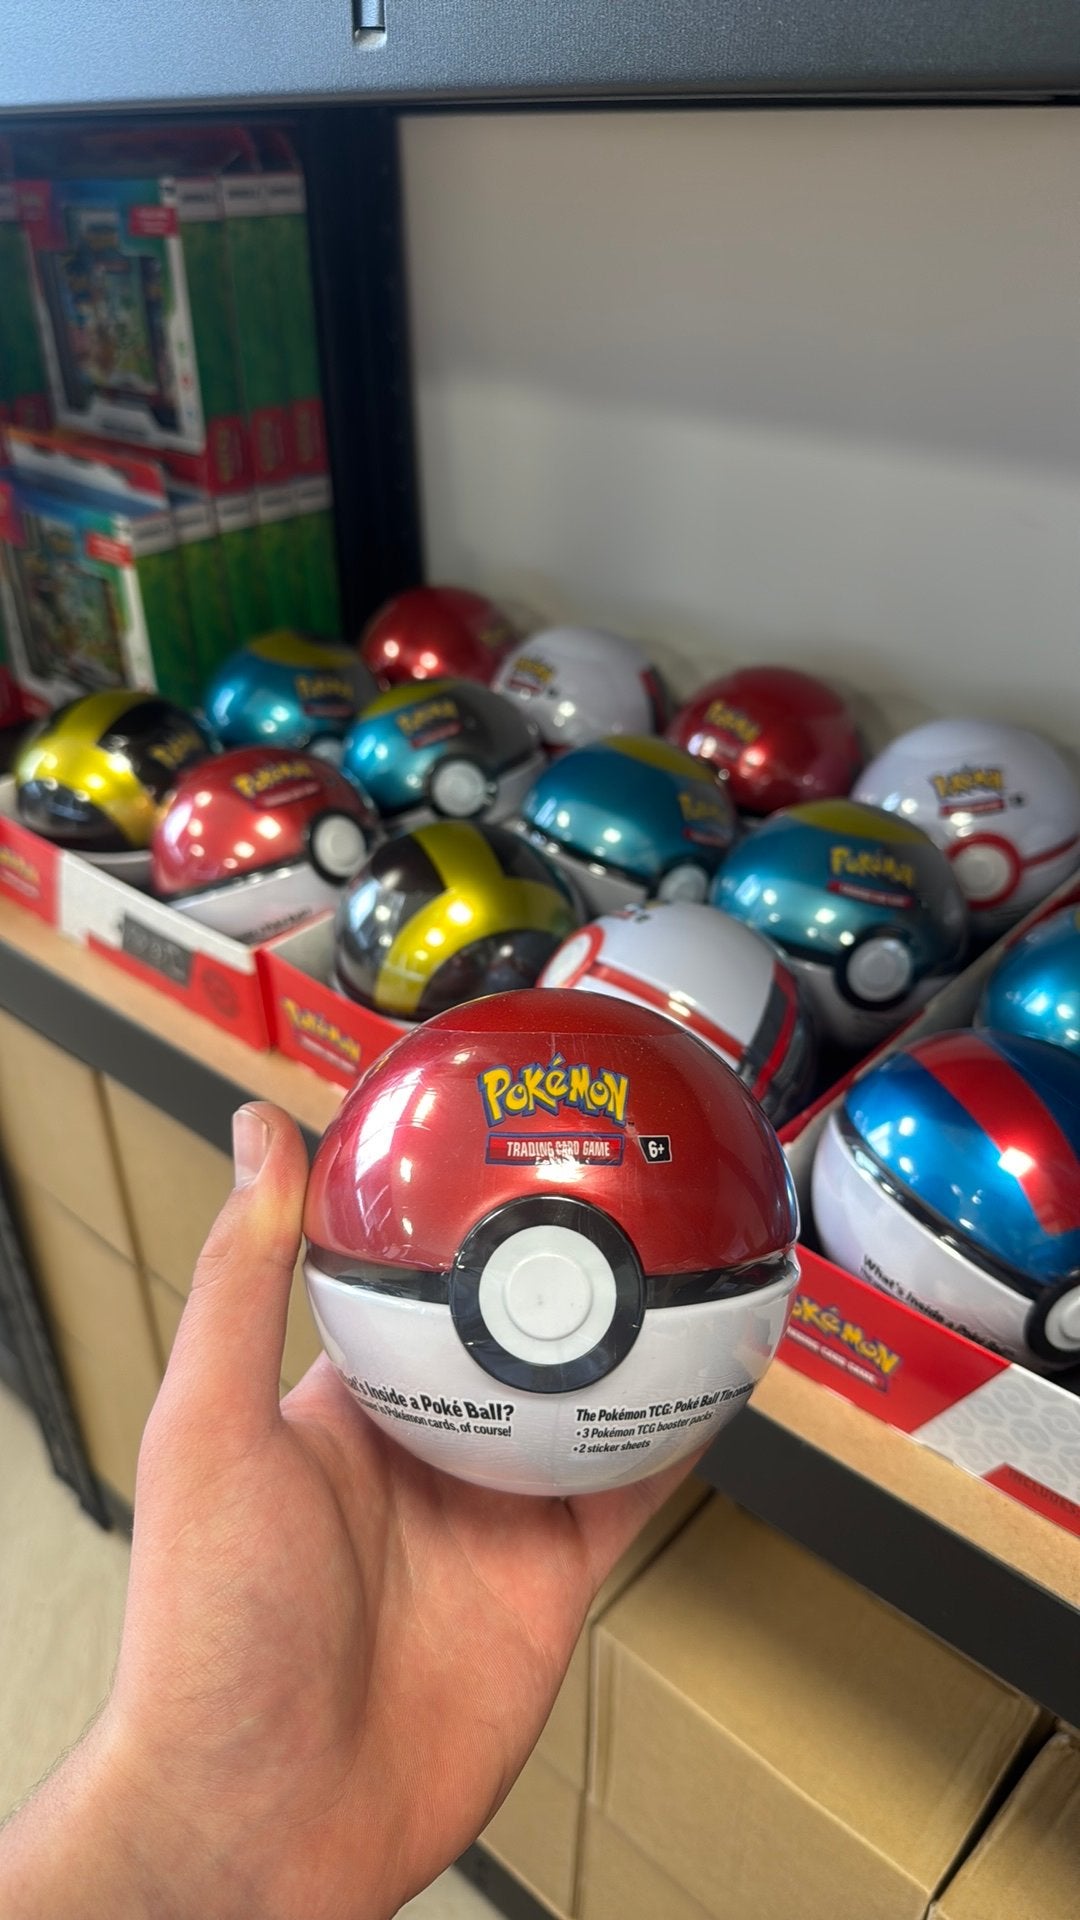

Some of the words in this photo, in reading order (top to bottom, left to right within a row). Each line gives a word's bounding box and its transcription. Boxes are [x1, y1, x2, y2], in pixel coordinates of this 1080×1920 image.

[507, 1141, 554, 1158] TRADING
[556, 1140, 580, 1157] CARD
[583, 1141, 610, 1157] GAME
[648, 1140, 665, 1158] 6+
[791, 1293, 901, 1375] OKéMON
[364, 1380, 408, 1408] Inside
[409, 1396, 421, 1411] a
[420, 1394, 464, 1418] Poké
[463, 1401, 514, 1421] Ball?
[576, 1408, 597, 1422] The
[598, 1407, 647, 1422] Pokémon
[648, 1404, 673, 1418] TCG:
[673, 1396, 700, 1413] Poké
[700, 1391, 720, 1408] Ball
[384, 1404, 429, 1427] Pokémon
[428, 1417, 460, 1433] cards,
[460, 1421, 473, 1433] of
[473, 1424, 512, 1437] course!
[590, 1427, 635, 1439] Pokémon
[637, 1424, 657, 1435] TCG
[656, 1418, 689, 1433] booster
[688, 1410, 714, 1427] packs
[587, 1443, 618, 1453] sticker
[620, 1440, 651, 1451] sheets
